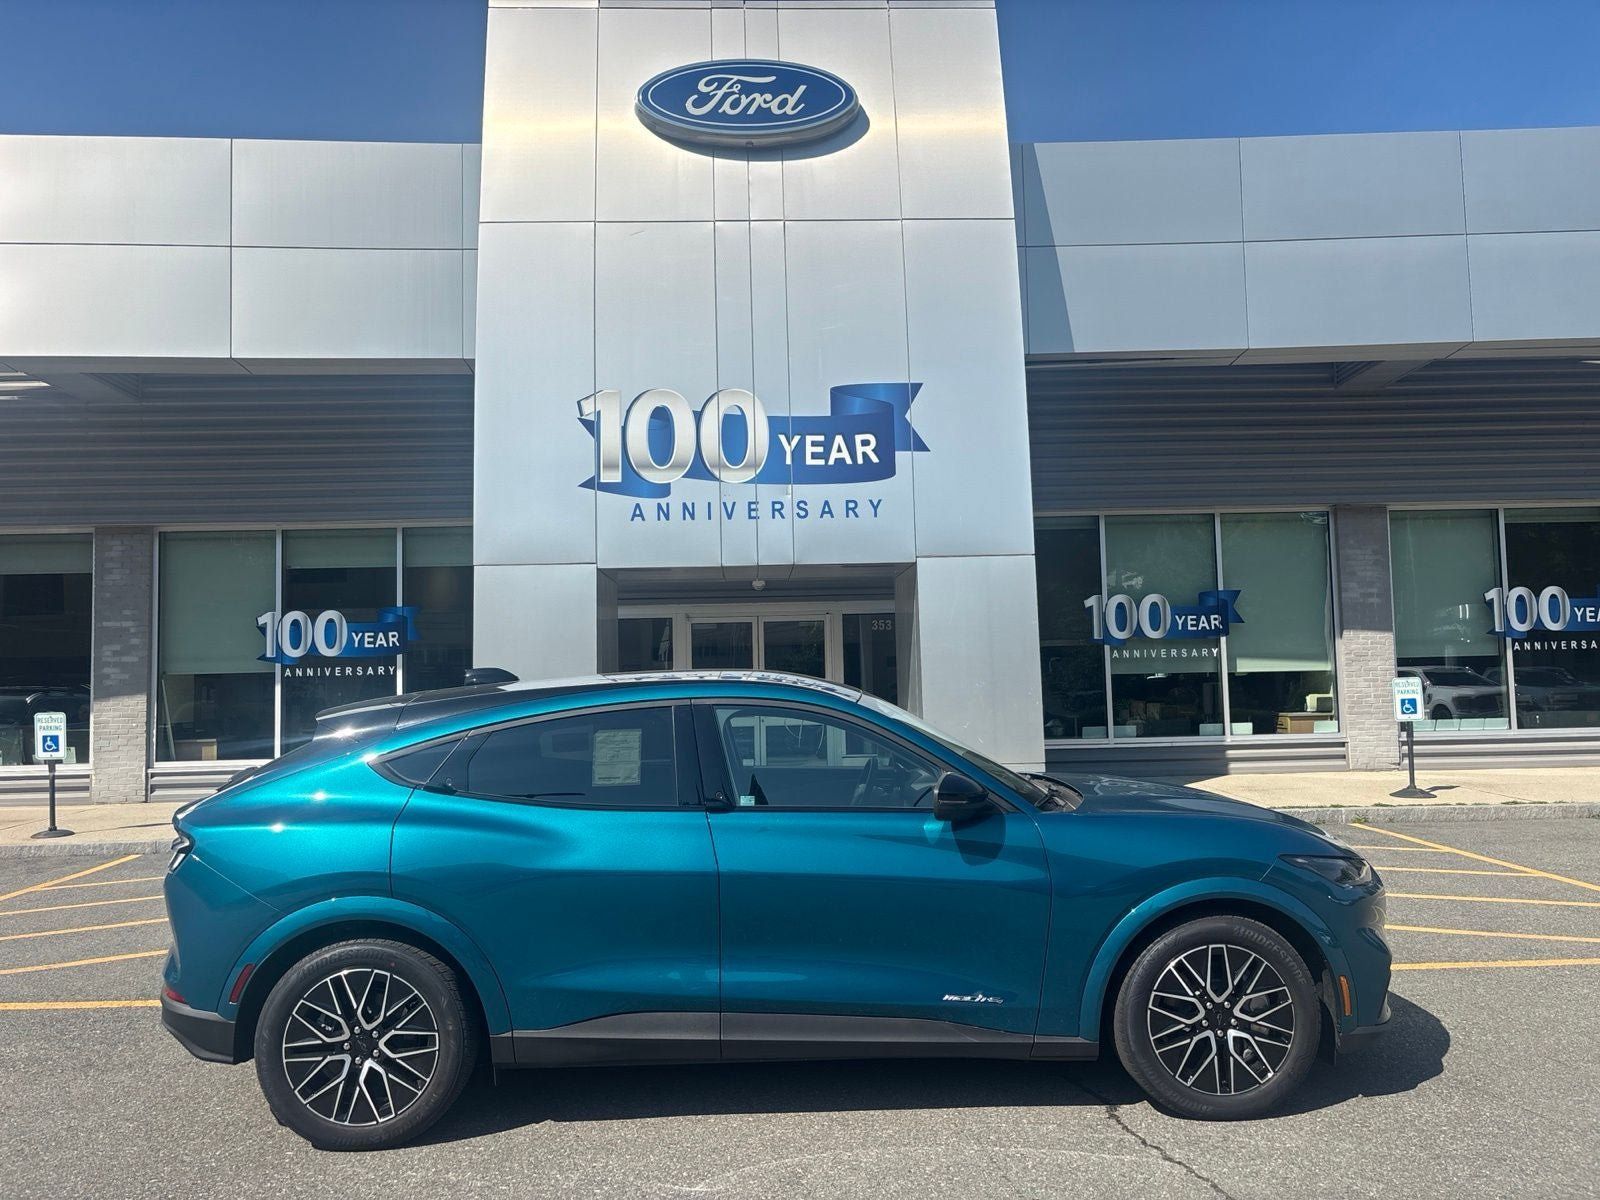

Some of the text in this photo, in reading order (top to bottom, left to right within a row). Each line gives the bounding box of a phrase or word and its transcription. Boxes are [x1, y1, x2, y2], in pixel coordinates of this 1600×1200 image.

[685, 74, 807, 116] Ford
[577, 388, 880, 484] 100 YEAR
[630, 498, 883, 522] ANNIVERSARY
[871, 619, 892, 631] 353
[1083, 593, 1223, 640] 100 YEAR
[1484, 585, 1600, 632] 100 YE
[256, 609, 400, 658] 100 YEAR
[1112, 647, 1219, 659] ANNIVERSARY
[284, 665, 397, 678] ANNIVERSARY
